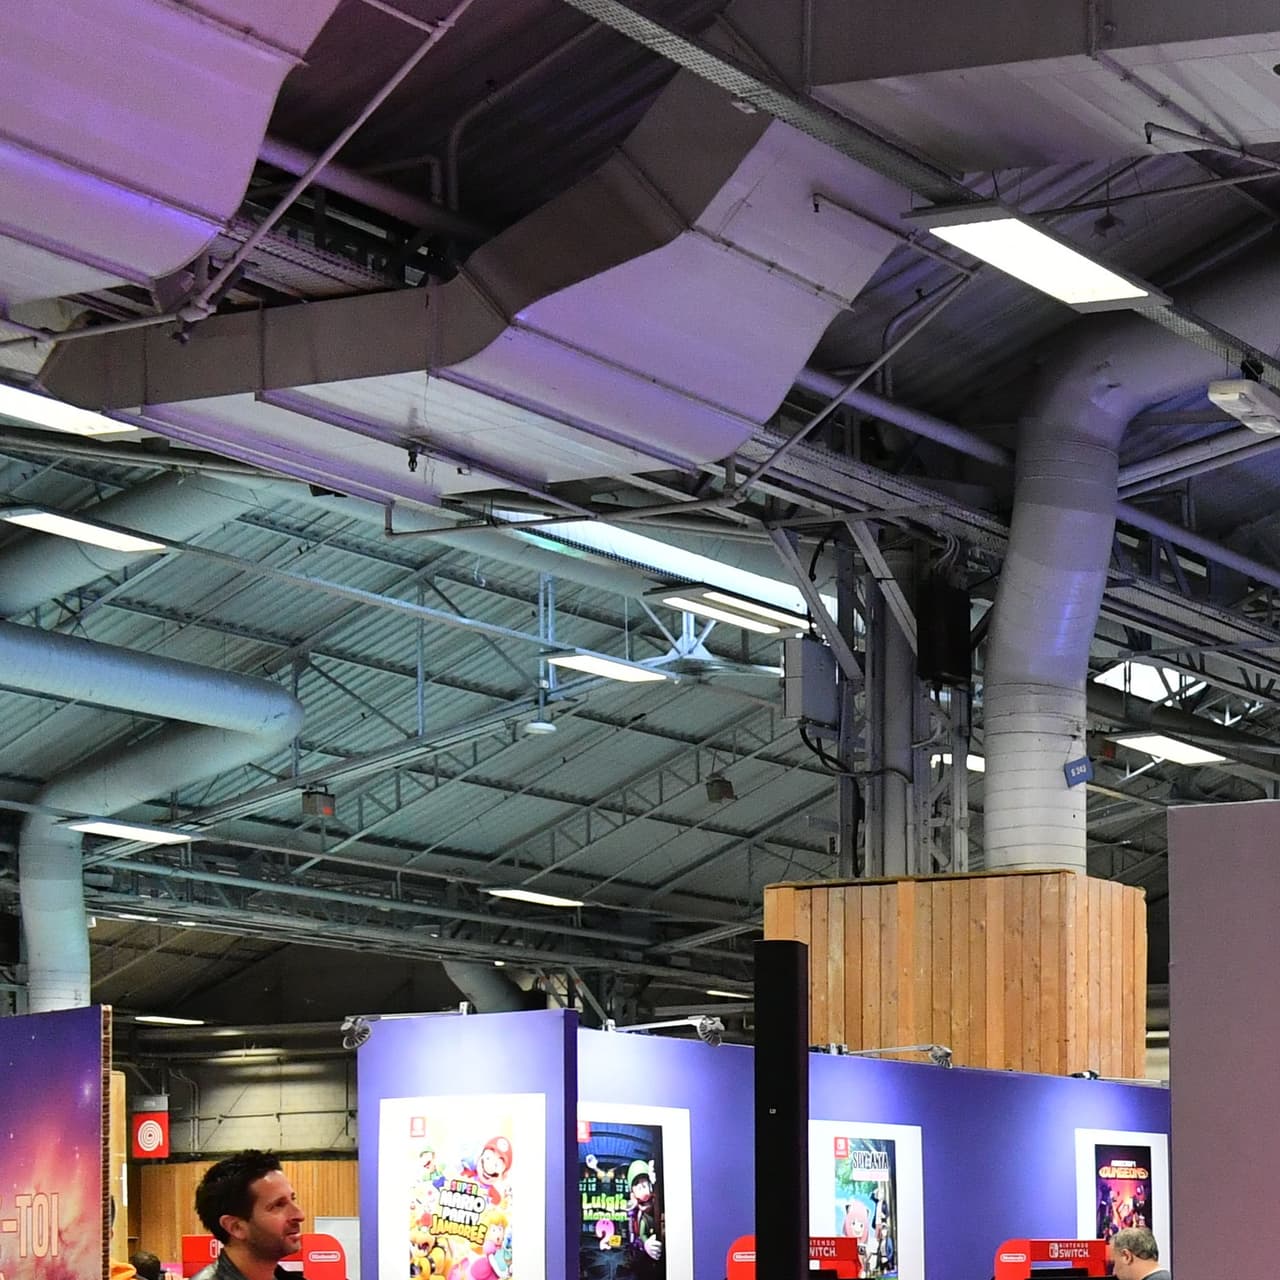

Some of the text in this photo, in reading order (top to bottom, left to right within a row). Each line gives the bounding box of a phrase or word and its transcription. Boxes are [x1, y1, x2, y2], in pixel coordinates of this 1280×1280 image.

[439, 1190, 486, 1214] MARIO
[1, 1193, 59, 1257] -TOI
[809, 1247, 837, 1257] WITCH
[1060, 1248, 1089, 1258] SWITCH
